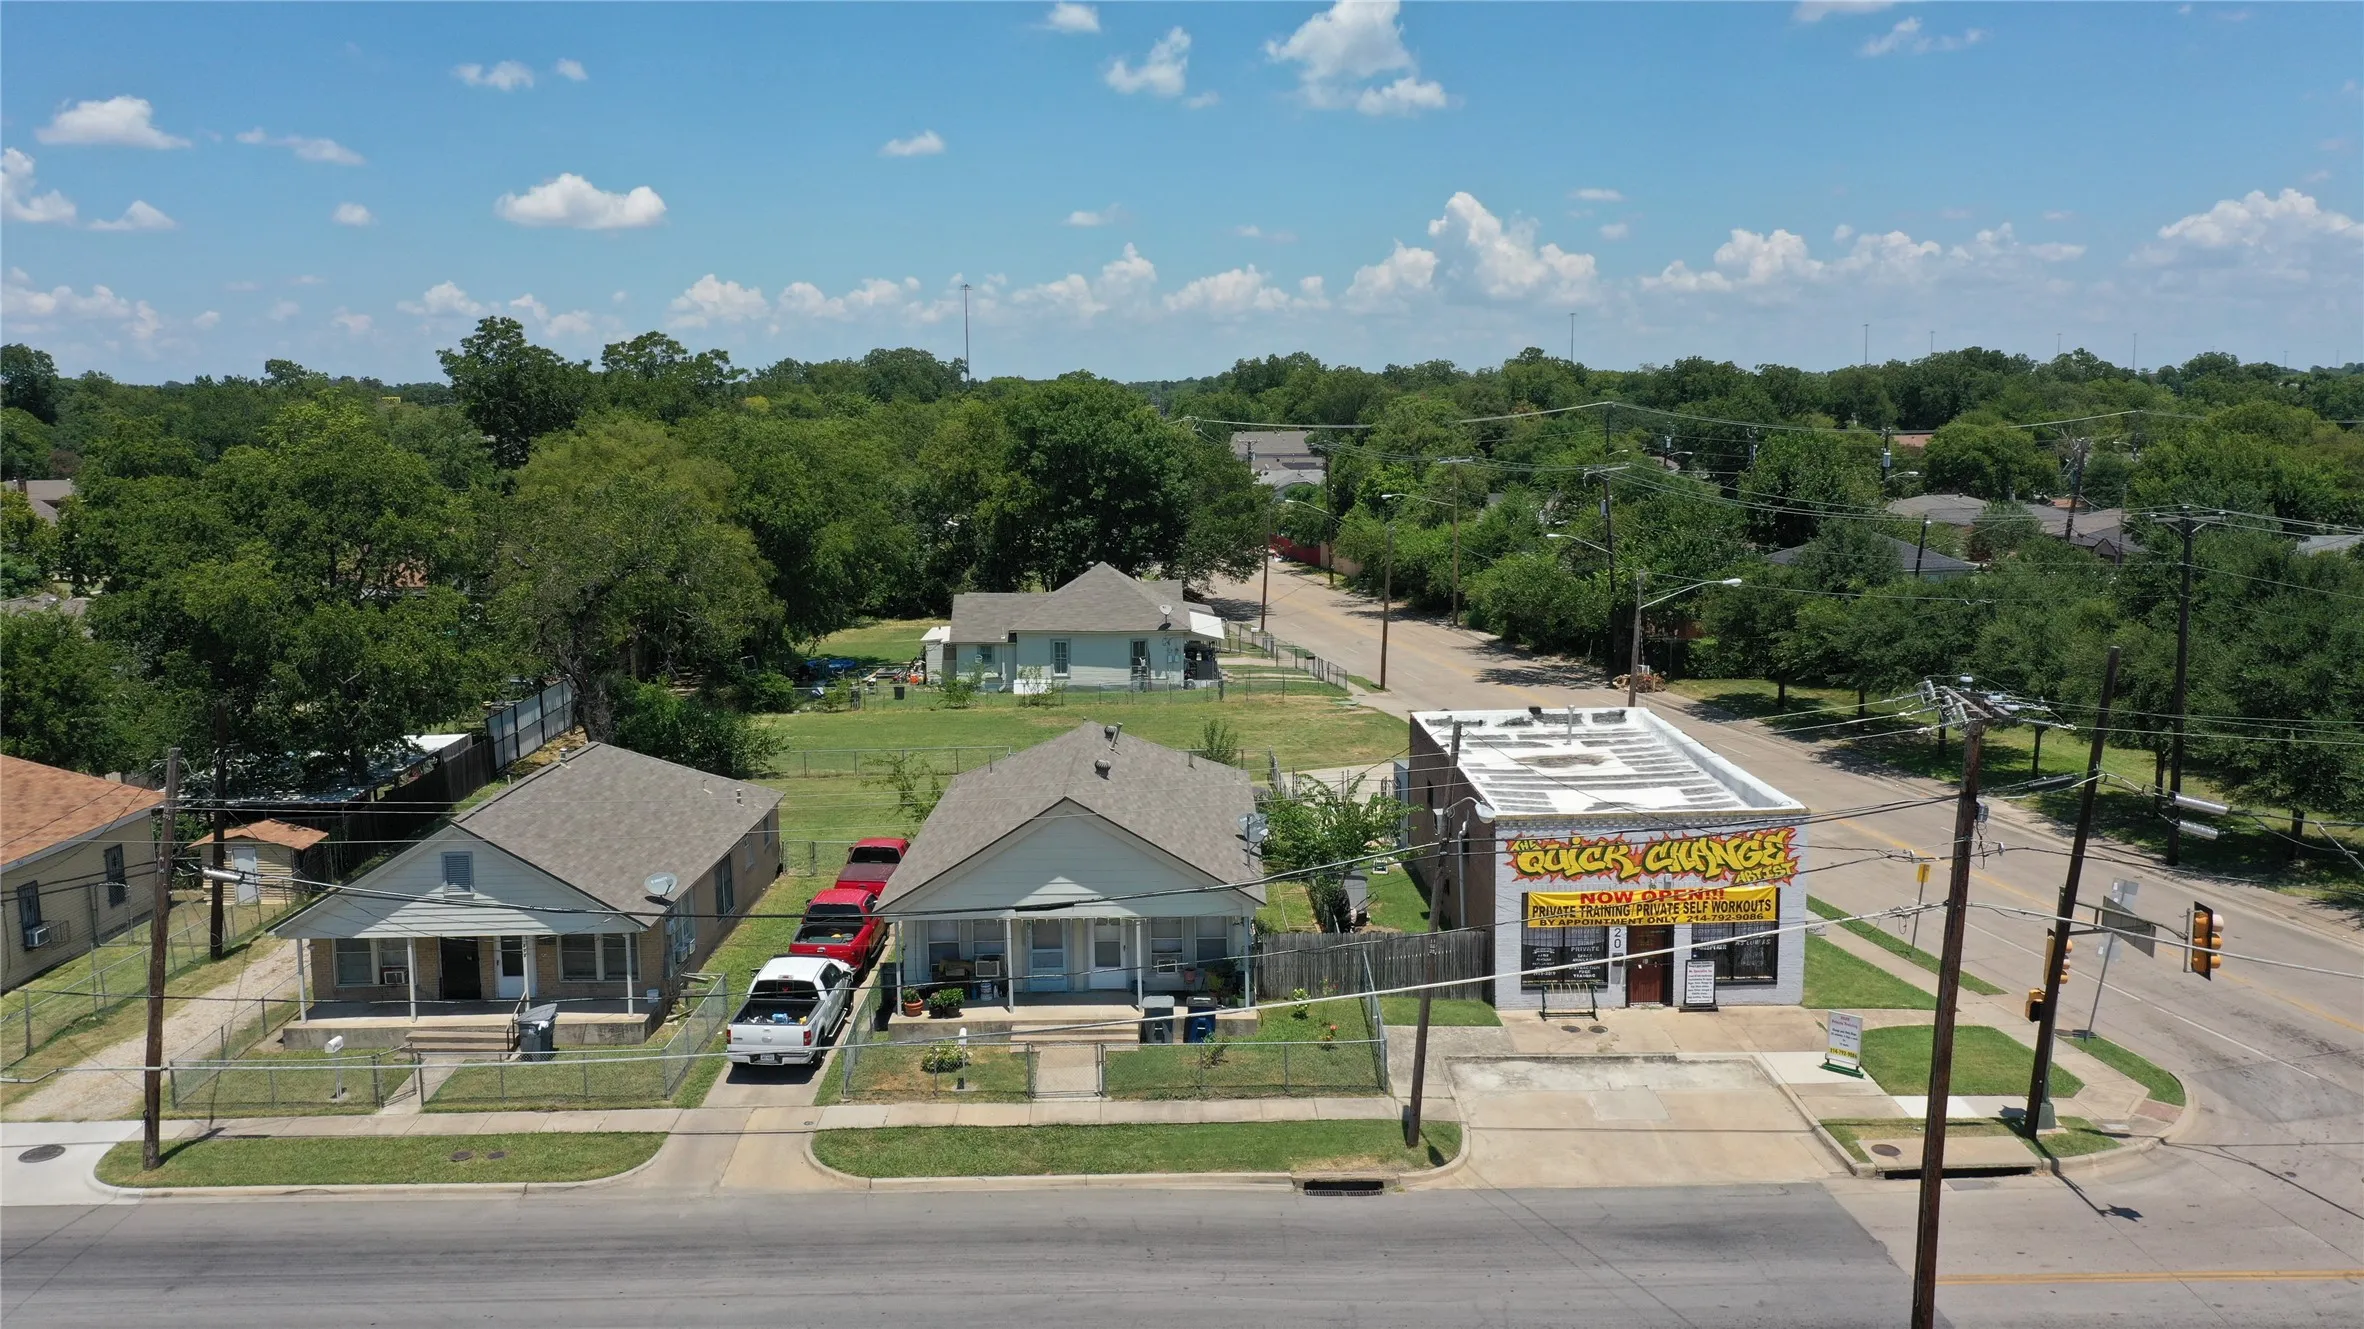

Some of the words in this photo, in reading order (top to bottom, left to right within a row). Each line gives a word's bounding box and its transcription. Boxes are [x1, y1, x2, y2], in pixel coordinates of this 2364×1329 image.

[1644, 830, 1789, 879] CHANGE
[1734, 861, 1796, 884] ARTIST
[1580, 891, 1634, 905] NOW
[1641, 889, 1725, 903] OPEN!!!
[1532, 905, 1576, 918] PRIVATE
[1683, 900, 1708, 915] SELF
[1711, 898, 1772, 914] WORKOUTS
[1557, 918, 1644, 926] APPOINTMENT
[1647, 916, 1678, 924] ONLY
[1686, 912, 1764, 922] 214-792-9086
